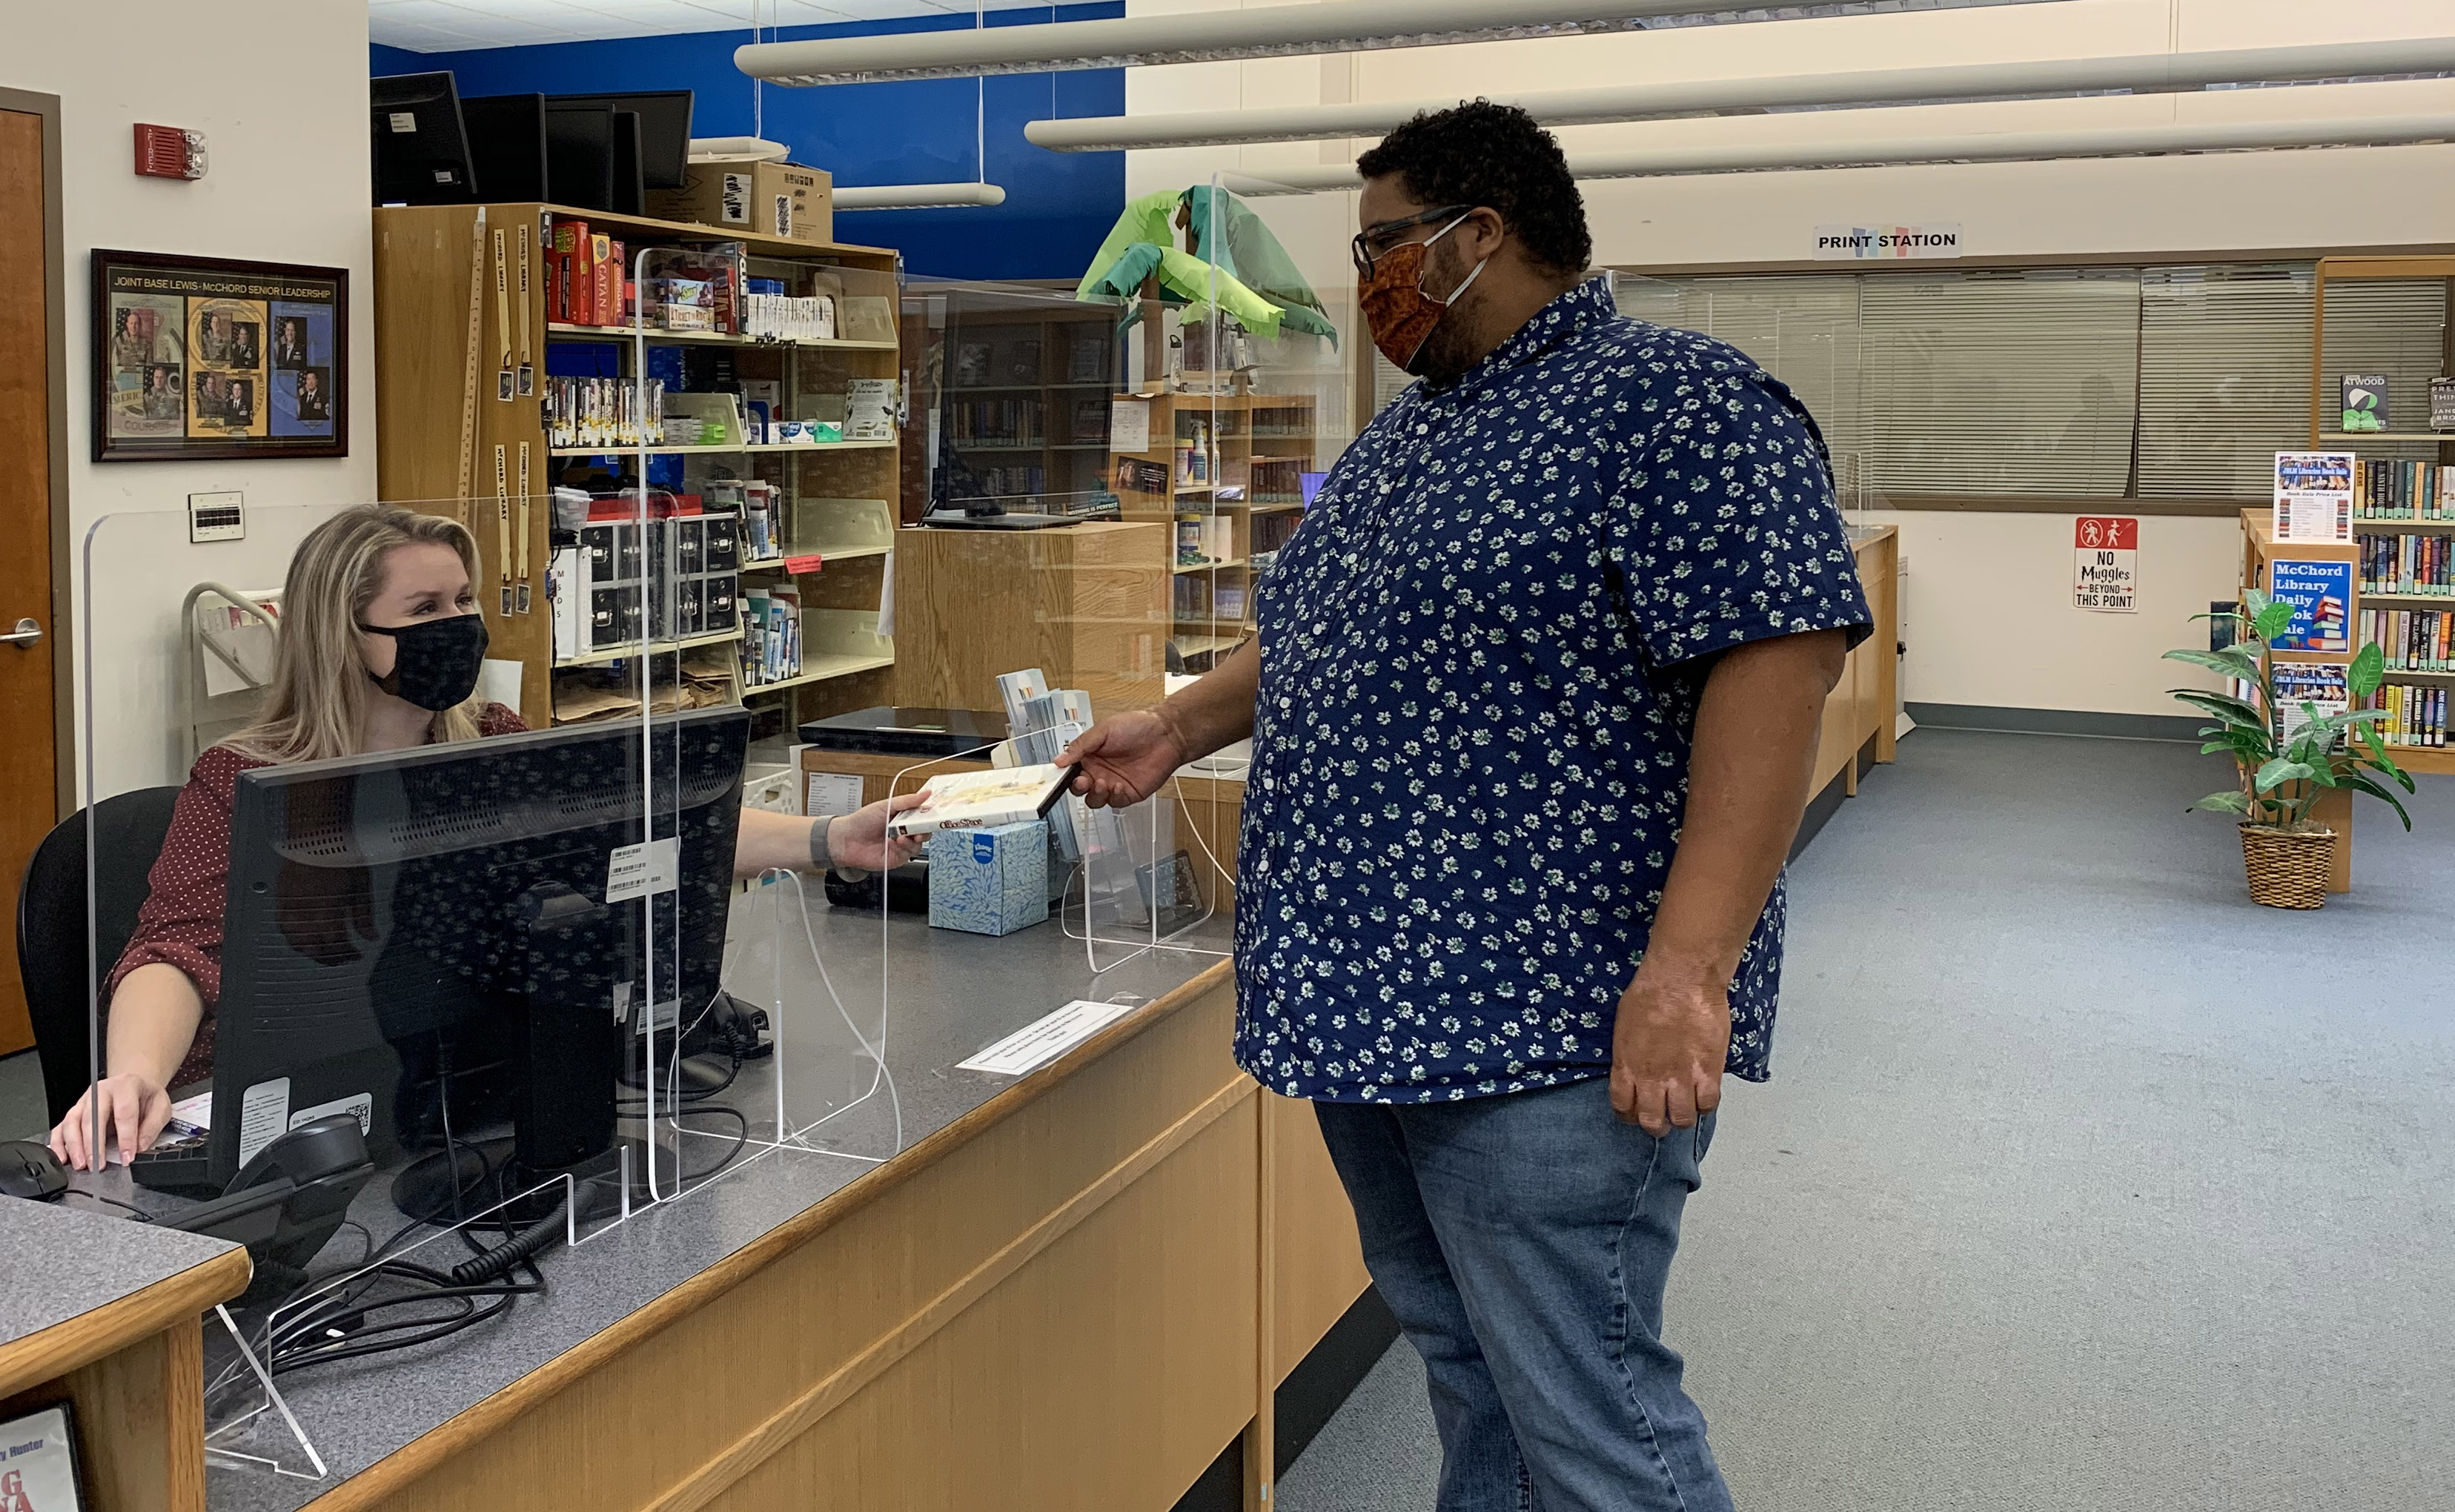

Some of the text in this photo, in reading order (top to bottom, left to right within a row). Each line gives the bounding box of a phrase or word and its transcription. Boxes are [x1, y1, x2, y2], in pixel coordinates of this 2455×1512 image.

[1819, 233, 1956, 248] PRINT STATION
[114, 276, 142, 287] JOINT
[144, 278, 168, 288] BASE
[248, 285, 279, 296] SENIOR
[281, 288, 331, 298] LEADERSHIP
[598, 264, 607, 308] CATAN
[1067, 508, 1090, 516] NOTHING
[1096, 502, 1118, 511] PERFECT
[2097, 551, 2114, 566] NO
[2081, 566, 2130, 583] Muggles
[2276, 564, 2343, 576] McChord
[2089, 584, 2120, 594] BEYOND
[2276, 579, 2330, 593] Library
[2076, 594, 2133, 607] THIS POINT
[2275, 594, 2314, 608] Daily
[2284, 623, 2305, 634] ale
[10, 1439, 44, 1458] Hunter
